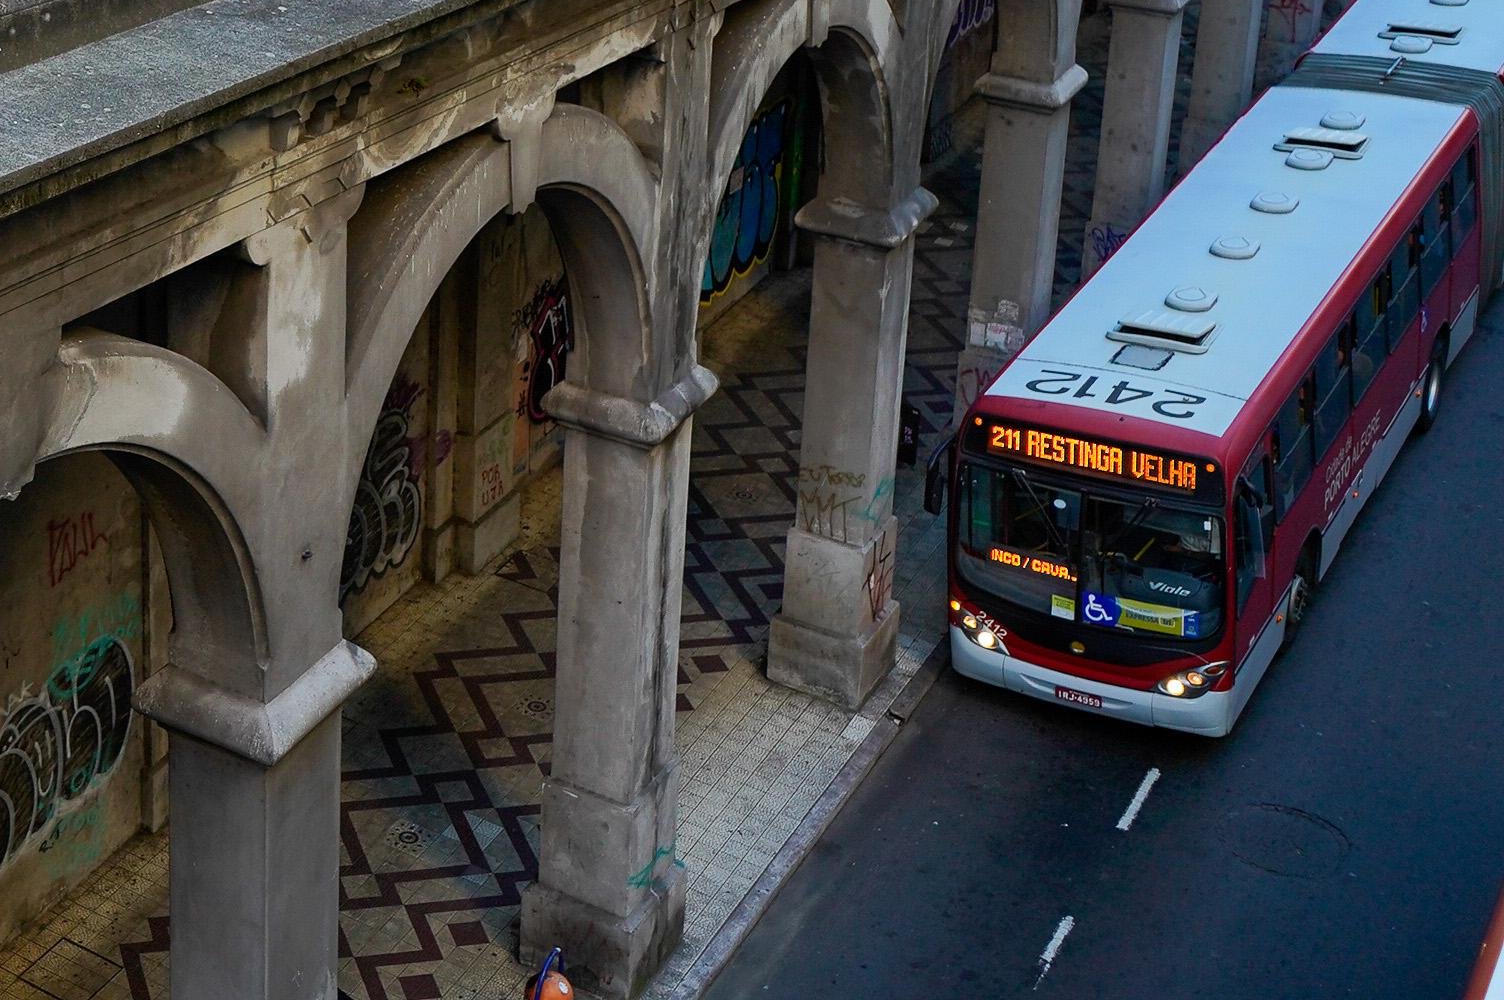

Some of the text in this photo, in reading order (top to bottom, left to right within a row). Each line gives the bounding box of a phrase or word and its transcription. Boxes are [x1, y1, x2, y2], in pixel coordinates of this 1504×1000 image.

[1025, 369, 1208, 419] 2412
[992, 425, 1197, 490] 211 RESTINGA VELHA
[1324, 416, 1381, 511] PORTO ALEGRE
[1149, 580, 1192, 598] Viale
[975, 610, 1009, 640] 2412
